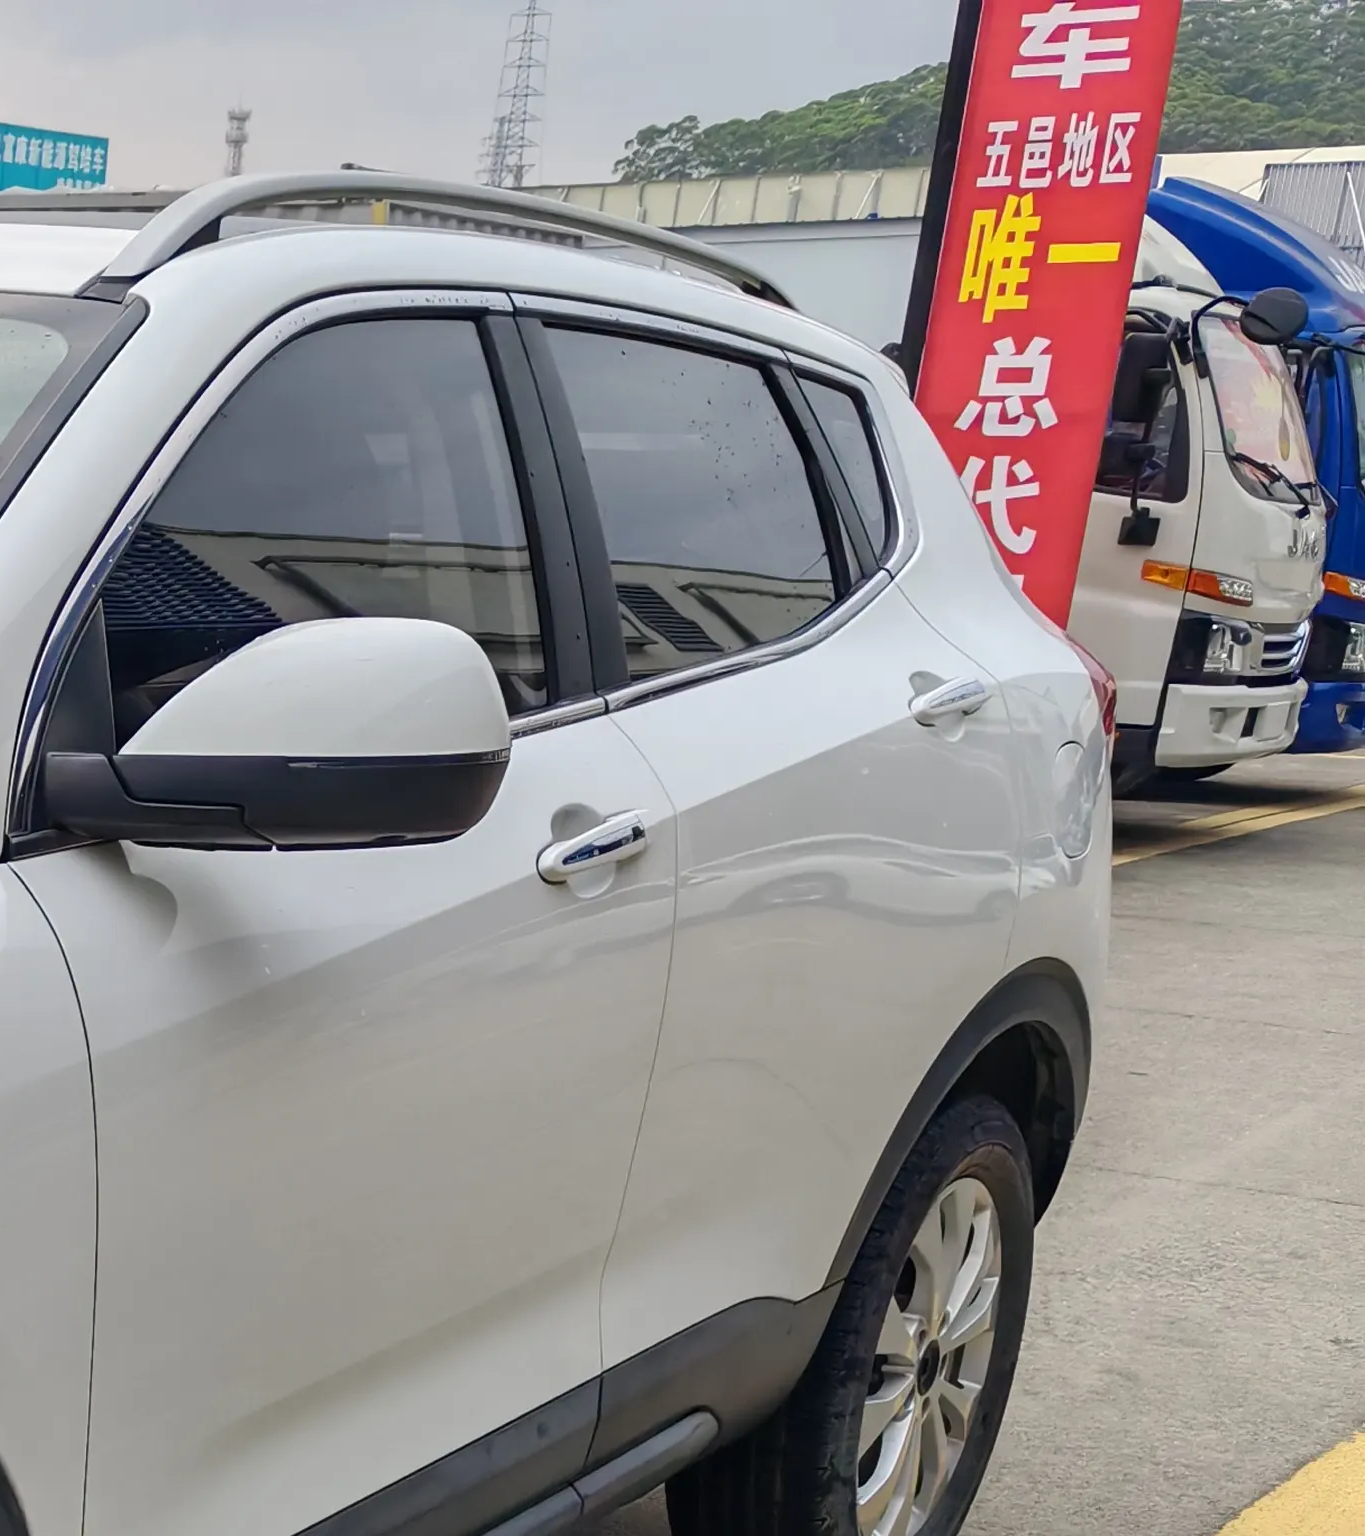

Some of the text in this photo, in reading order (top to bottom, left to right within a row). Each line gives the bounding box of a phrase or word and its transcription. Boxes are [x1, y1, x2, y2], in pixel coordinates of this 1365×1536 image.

[1010, 1, 1141, 89] 车
[976, 111, 1142, 188] 五邑地区
[958, 192, 1121, 323] 唯一
[954, 336, 1058, 590] 总代
